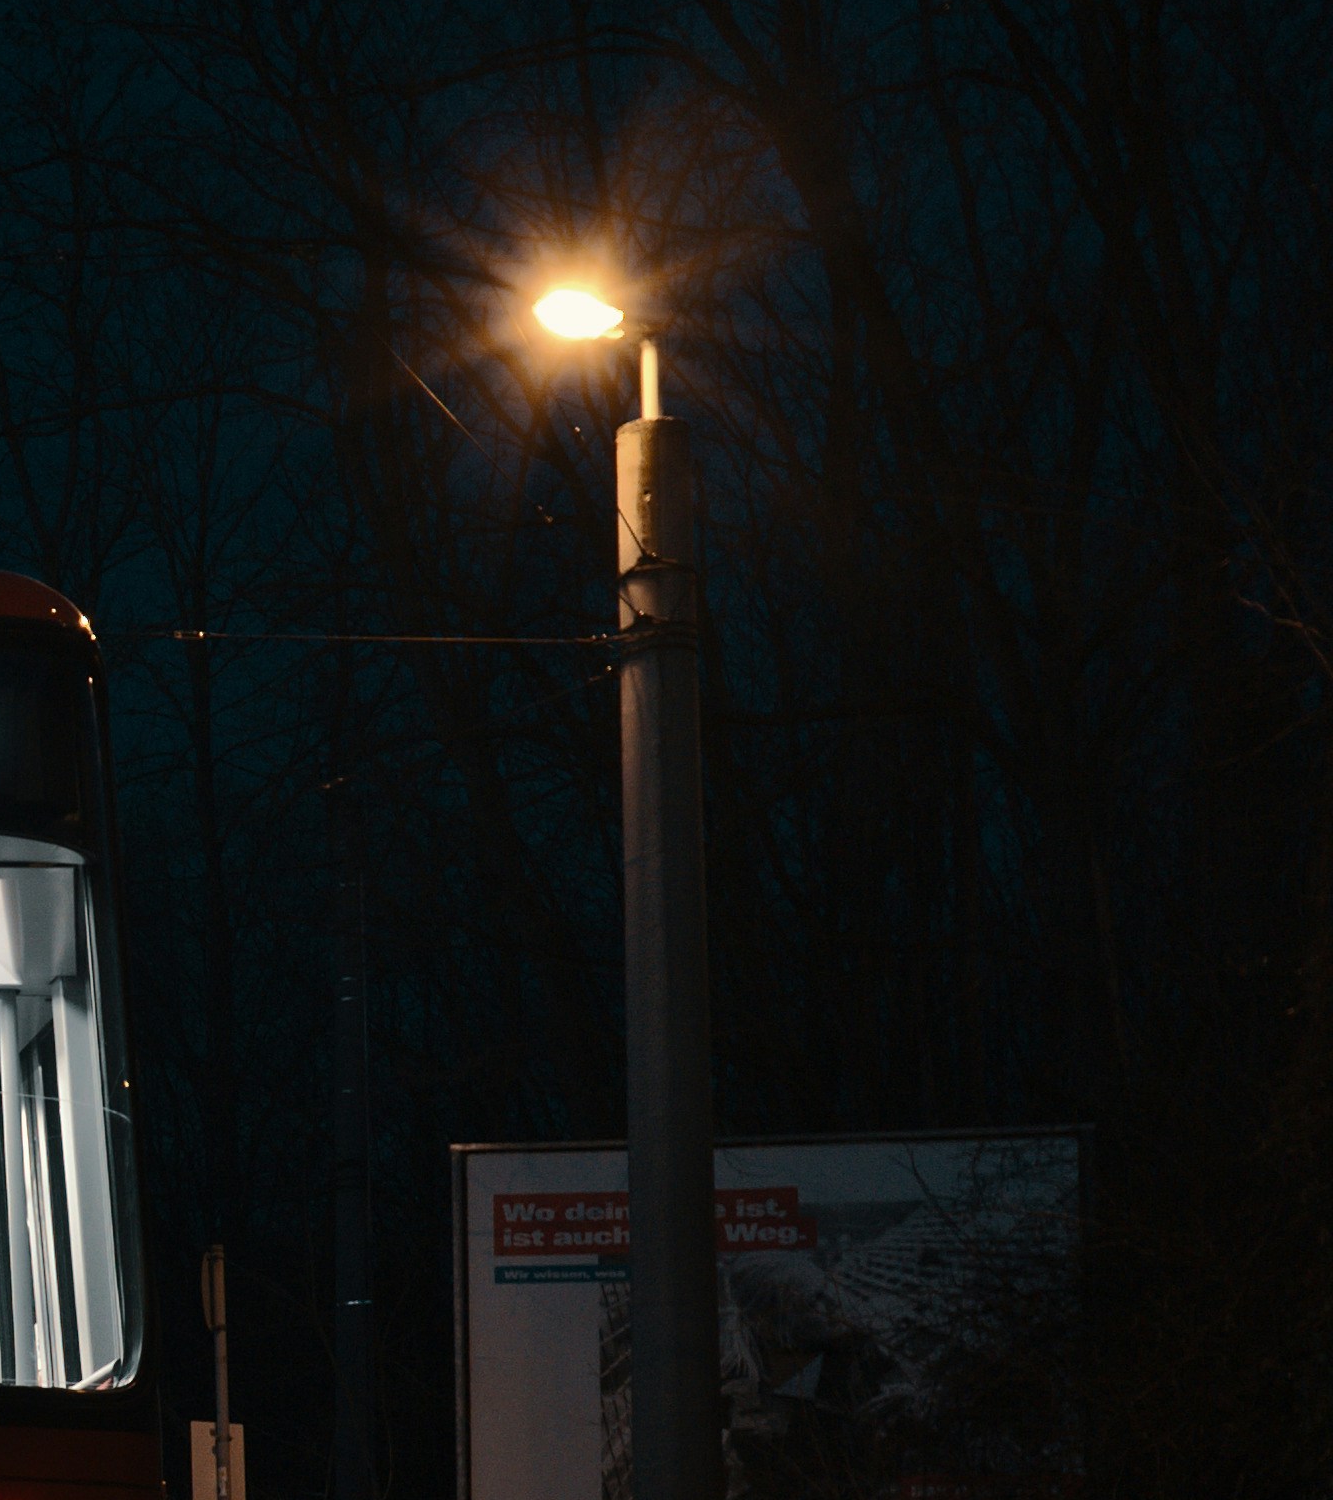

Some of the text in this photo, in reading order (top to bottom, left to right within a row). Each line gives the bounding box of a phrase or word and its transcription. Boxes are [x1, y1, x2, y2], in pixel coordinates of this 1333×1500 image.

[502, 1202, 555, 1222] Wo
[502, 1223, 807, 1248] ist auch Weg.
